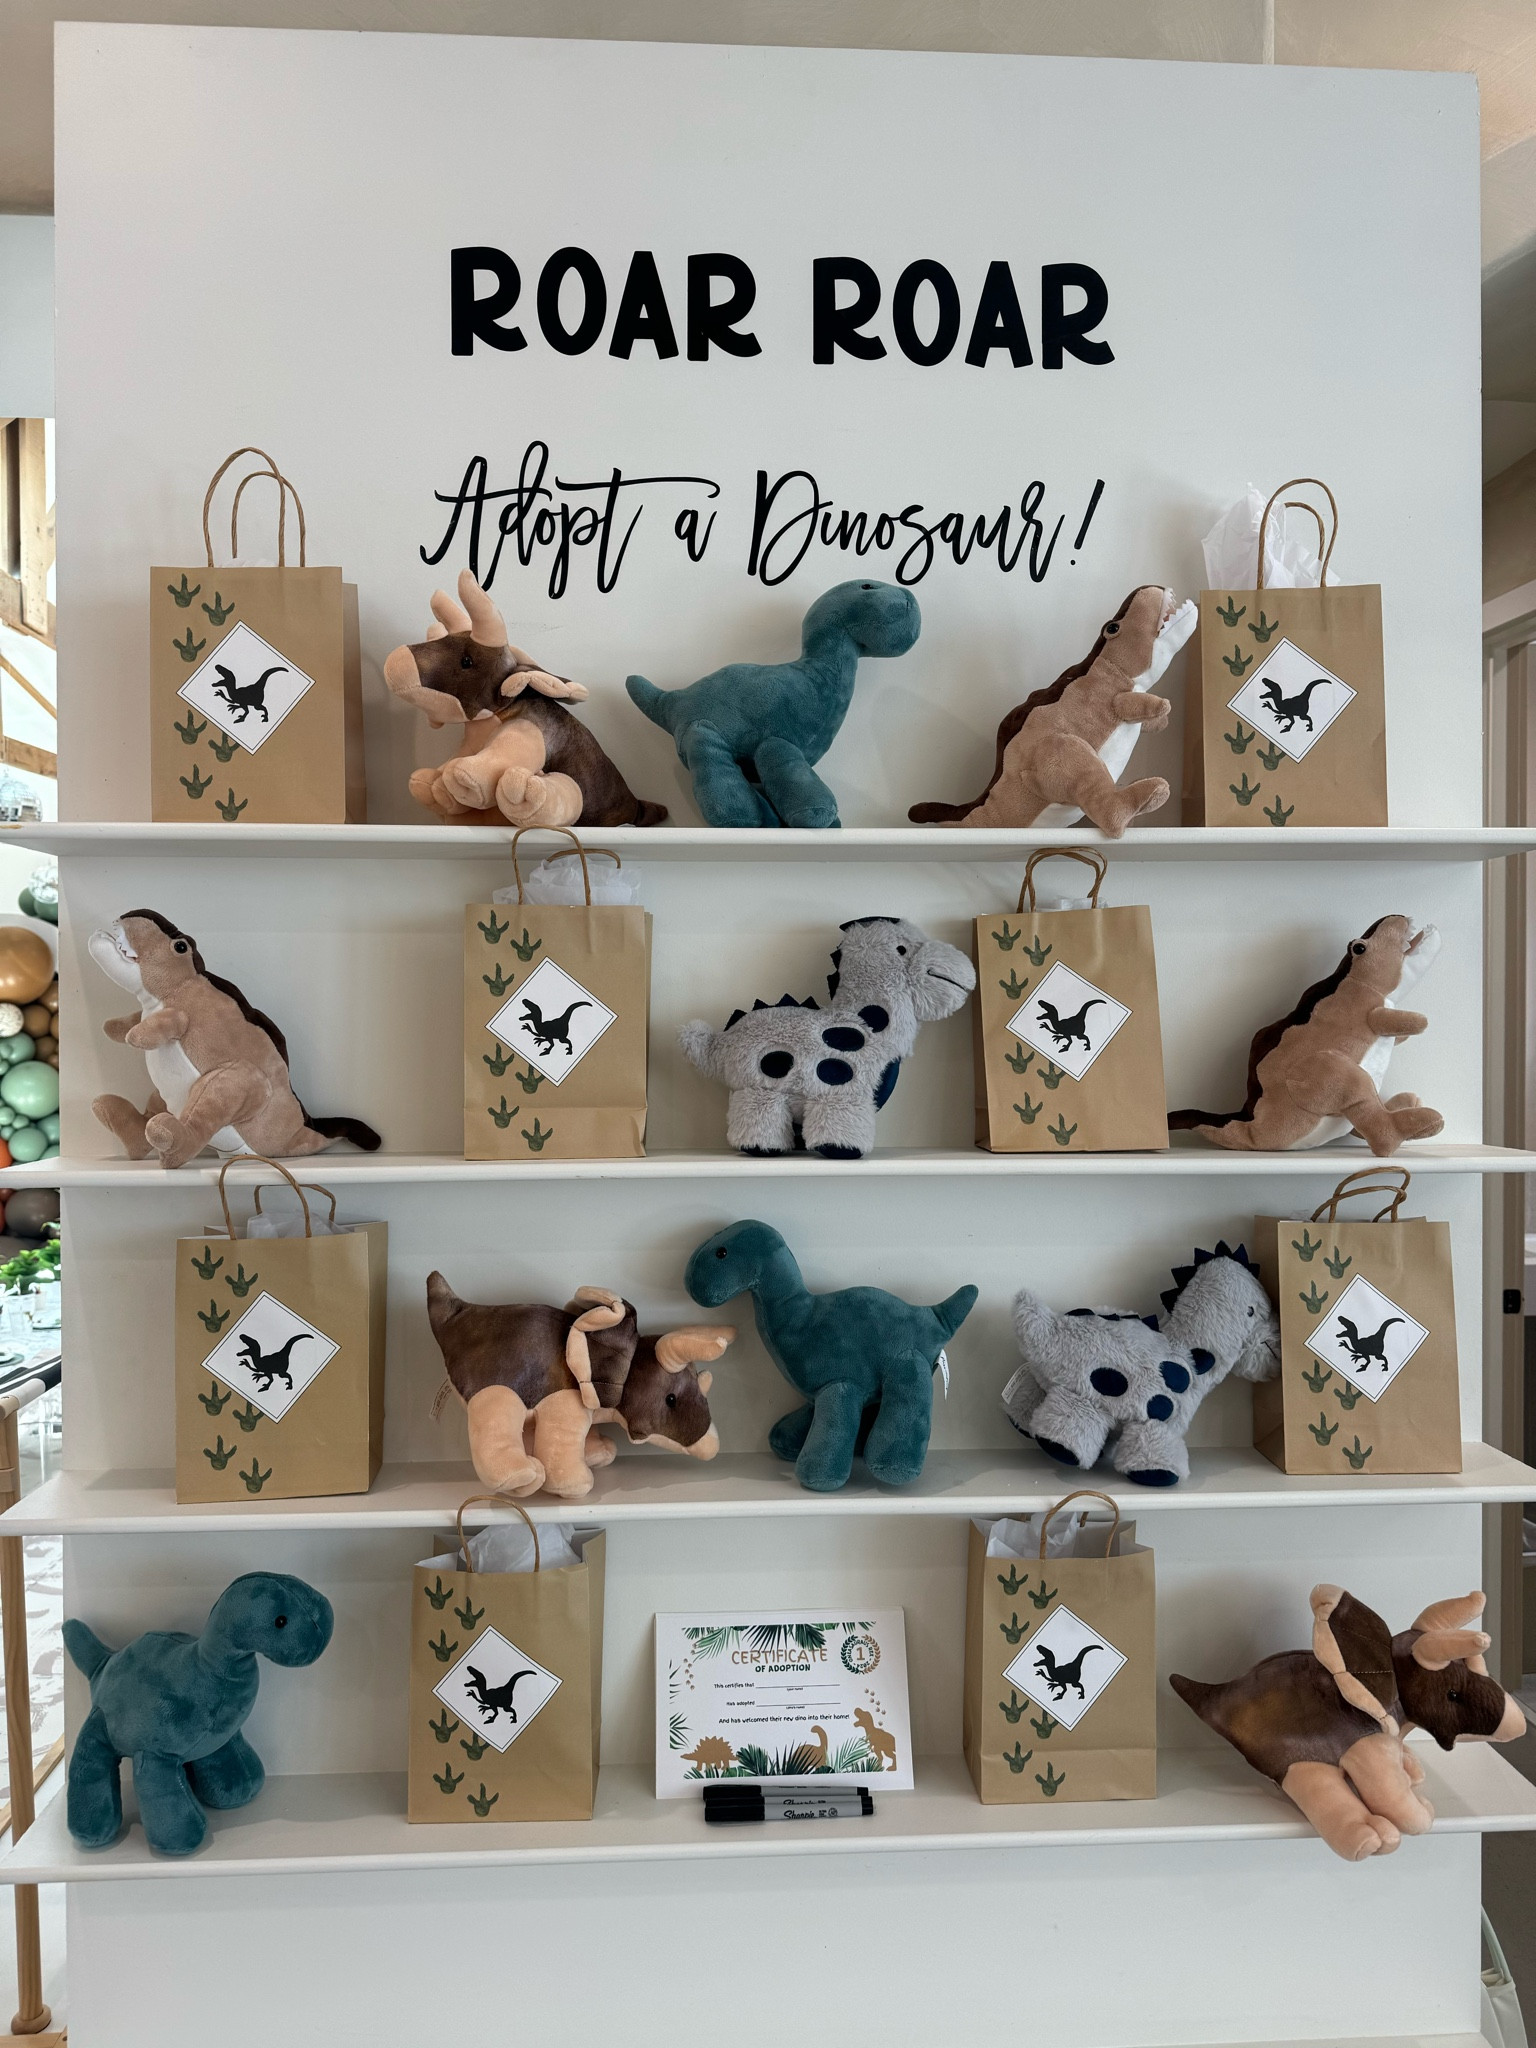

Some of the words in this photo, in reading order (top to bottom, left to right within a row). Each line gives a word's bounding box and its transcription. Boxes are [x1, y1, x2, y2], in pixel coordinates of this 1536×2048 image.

[451, 246, 762, 362] ROAR
[813, 257, 1115, 370] ROAR
[419, 440, 720, 600] Adopt
[674, 504, 717, 562] a
[747, 469, 1106, 587] Dinosaur!
[731, 1648, 828, 1665] CERTIFICATE
[856, 1646, 865, 1661] 1
[755, 1664, 766, 1673] OF
[768, 1663, 811, 1673] ADOPTION
[742, 1716, 769, 1724] welcomed
